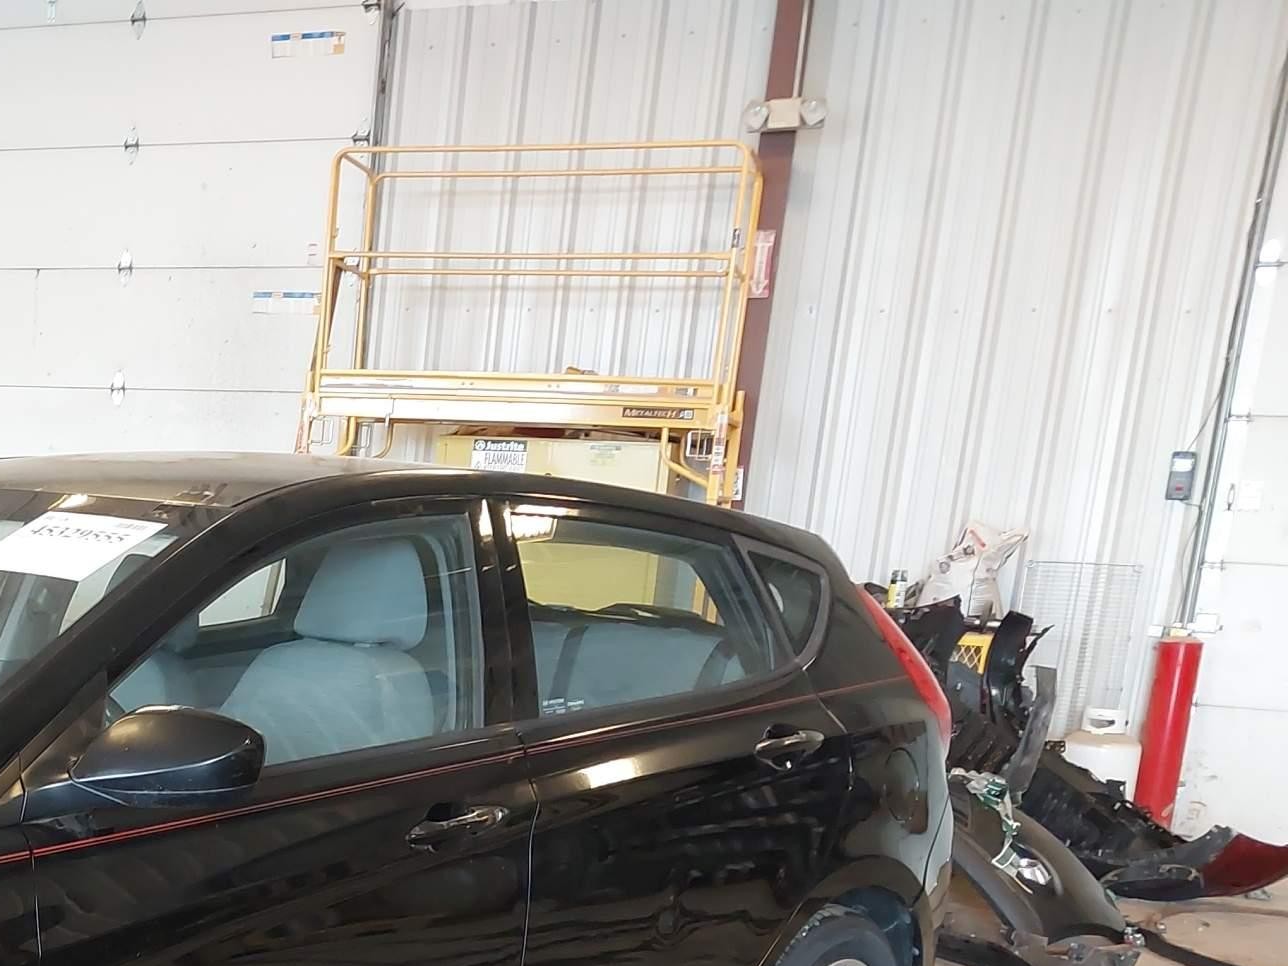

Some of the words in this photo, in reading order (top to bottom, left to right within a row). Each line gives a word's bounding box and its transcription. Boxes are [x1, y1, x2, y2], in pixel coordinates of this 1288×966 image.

[485, 441, 525, 451] Justrite
[485, 452, 525, 466] FLAMMABLE
[31, 524, 132, 544] 45329555
